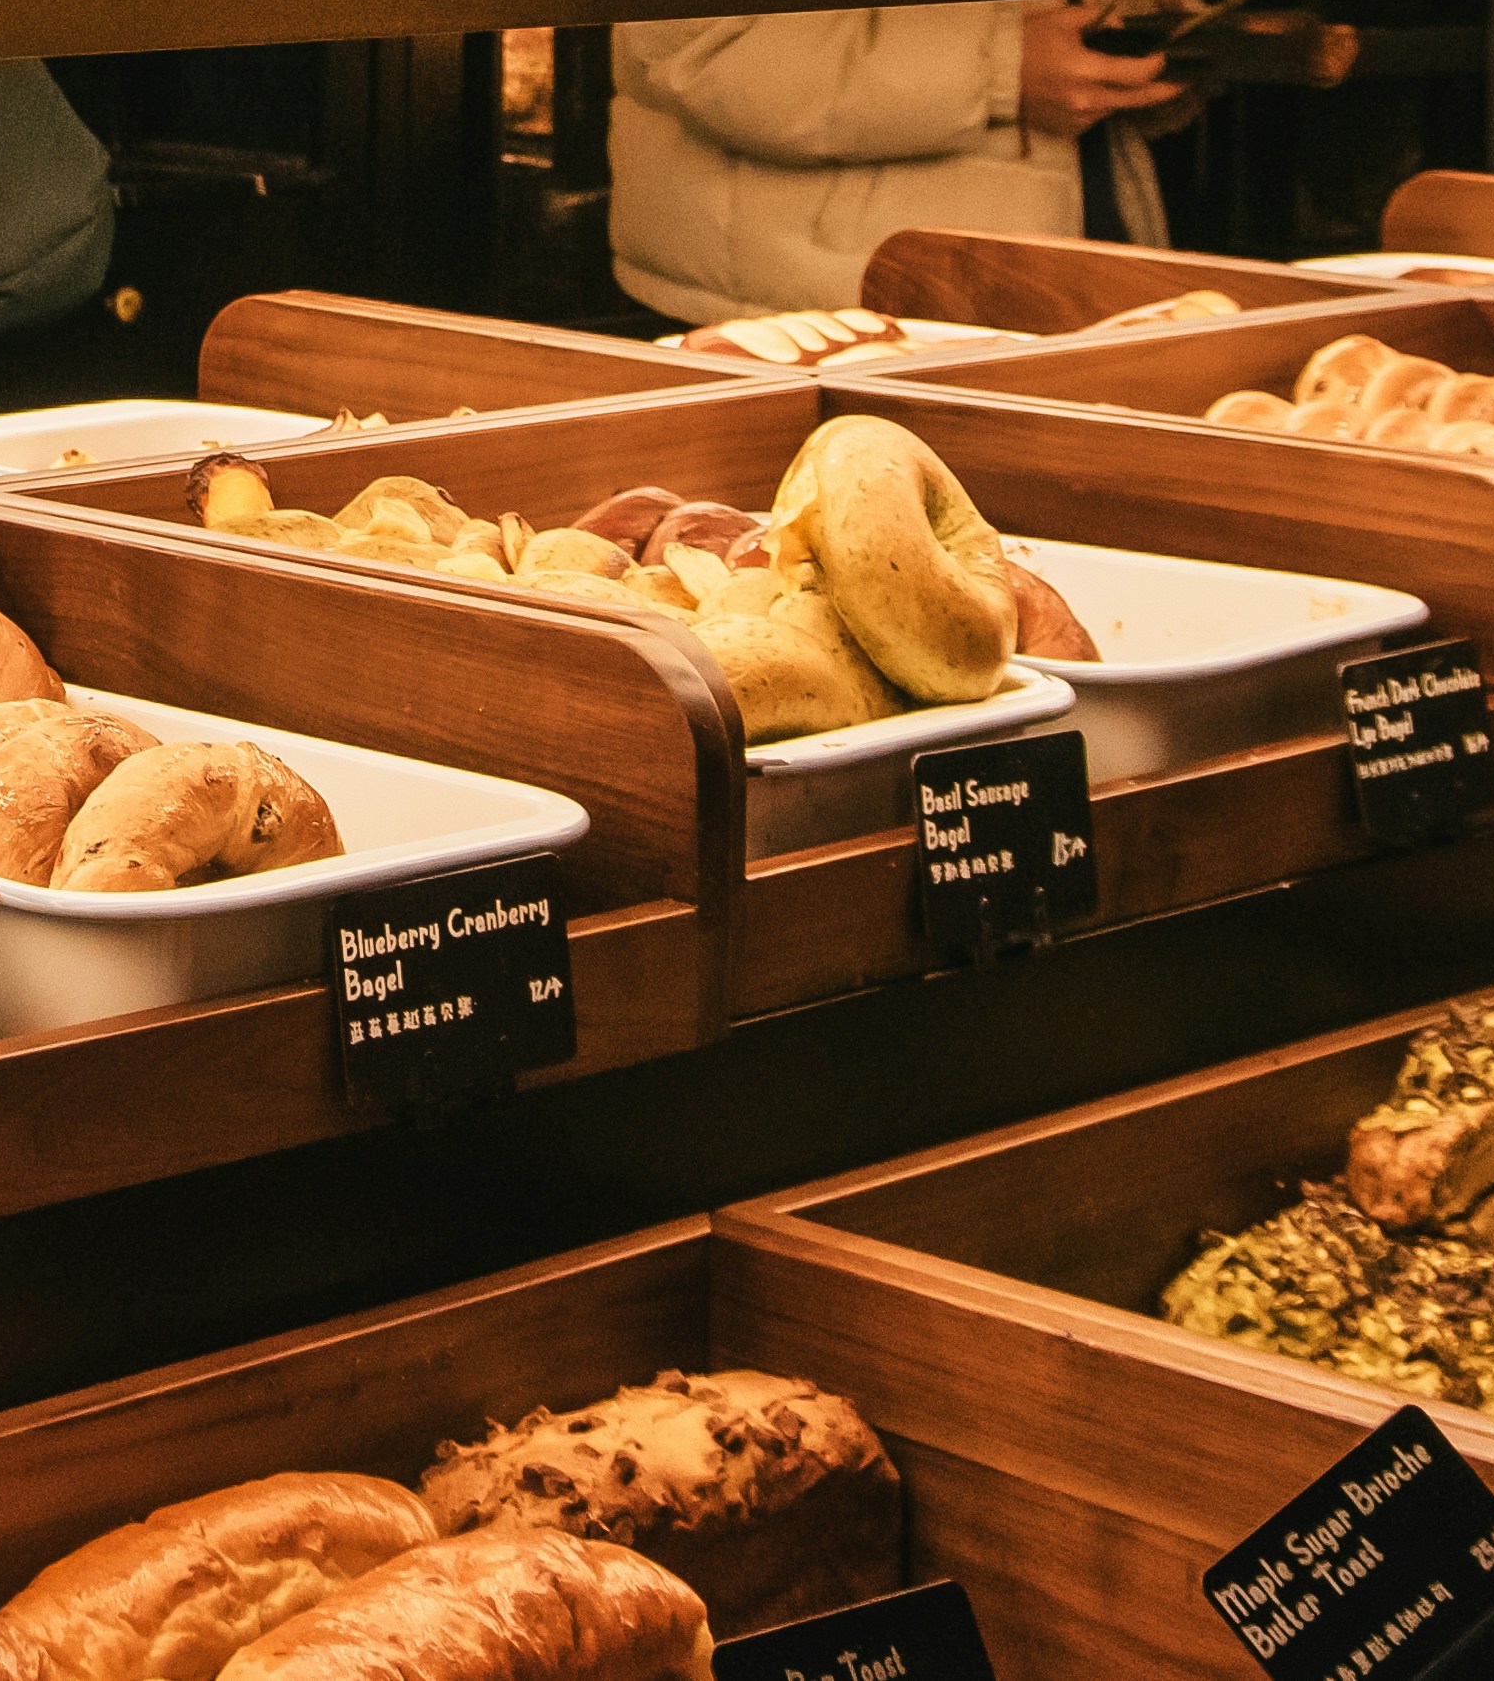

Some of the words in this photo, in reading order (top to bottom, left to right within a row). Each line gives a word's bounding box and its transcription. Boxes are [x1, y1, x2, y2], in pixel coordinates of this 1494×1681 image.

[921, 781, 962, 816] Basil
[964, 777, 1031, 808] Sausage
[924, 815, 972, 853] Bagel
[340, 922, 441, 964] Blueberry
[447, 897, 551, 940] Cranberry
[344, 960, 405, 1003] Bagel
[1213, 1557, 1295, 1624] Maple
[1284, 1507, 1354, 1567] Sugar
[1340, 1442, 1434, 1518] Brioche
[1240, 1592, 1322, 1661] Butter
[1311, 1535, 1386, 1596] Toast
